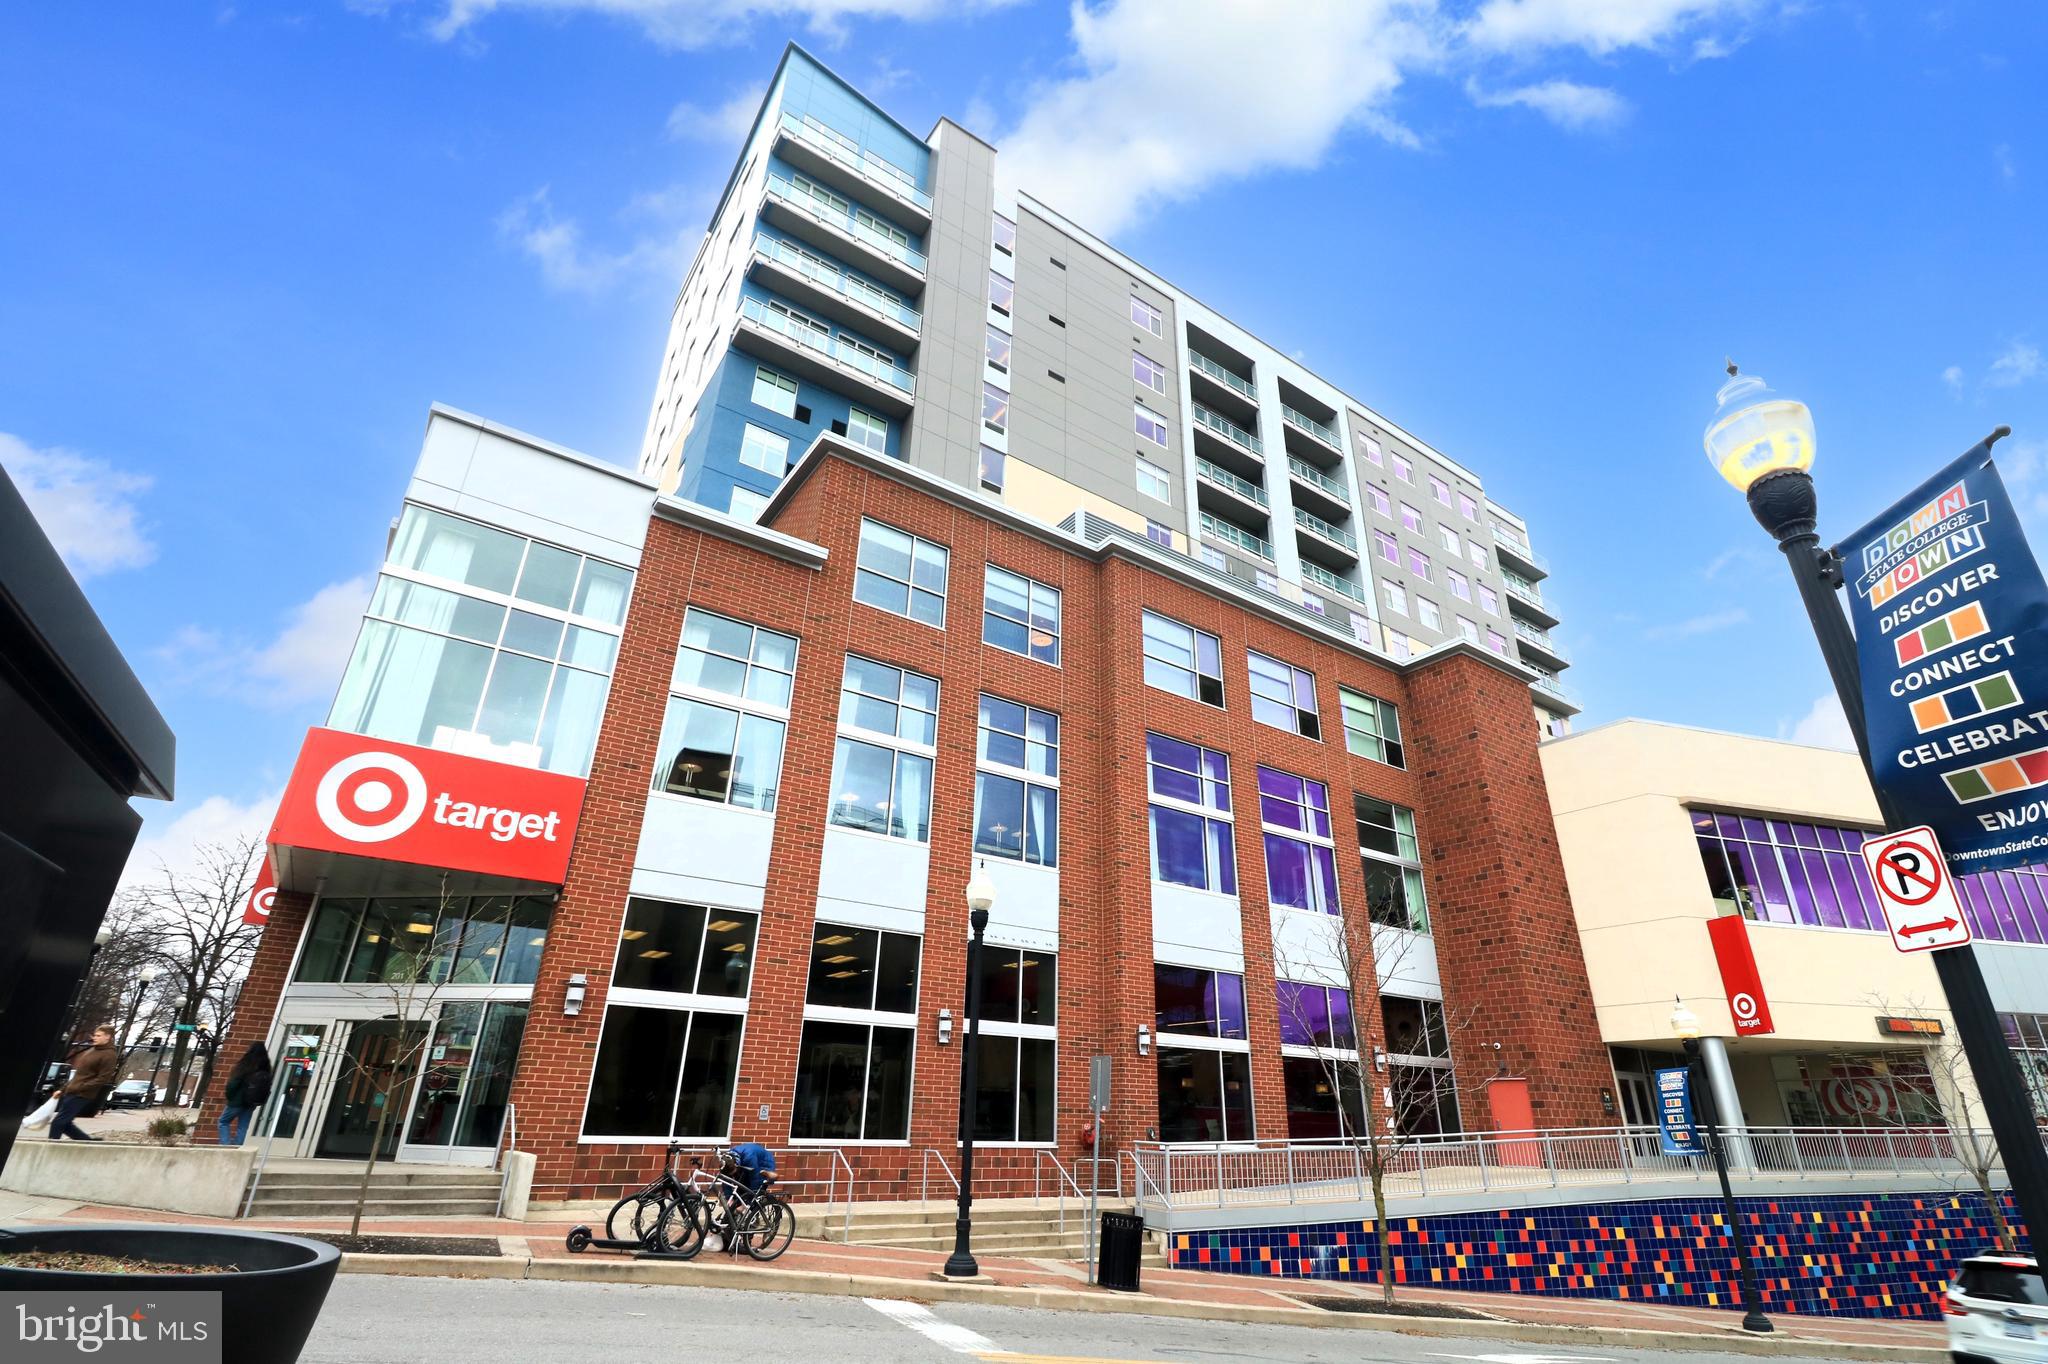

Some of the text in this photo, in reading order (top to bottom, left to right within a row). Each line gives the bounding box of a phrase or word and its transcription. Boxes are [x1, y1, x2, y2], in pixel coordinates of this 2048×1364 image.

[1870, 492, 1963, 565] DOWN
[1874, 528, 1973, 598] TOWN
[1880, 563, 1999, 634] DISCOVER
[1890, 635, 2015, 697] CONNECT
[433, 792, 561, 842] target
[1944, 833, 2048, 862] DowntownStateCo
[1738, 1017, 1761, 1028] target
